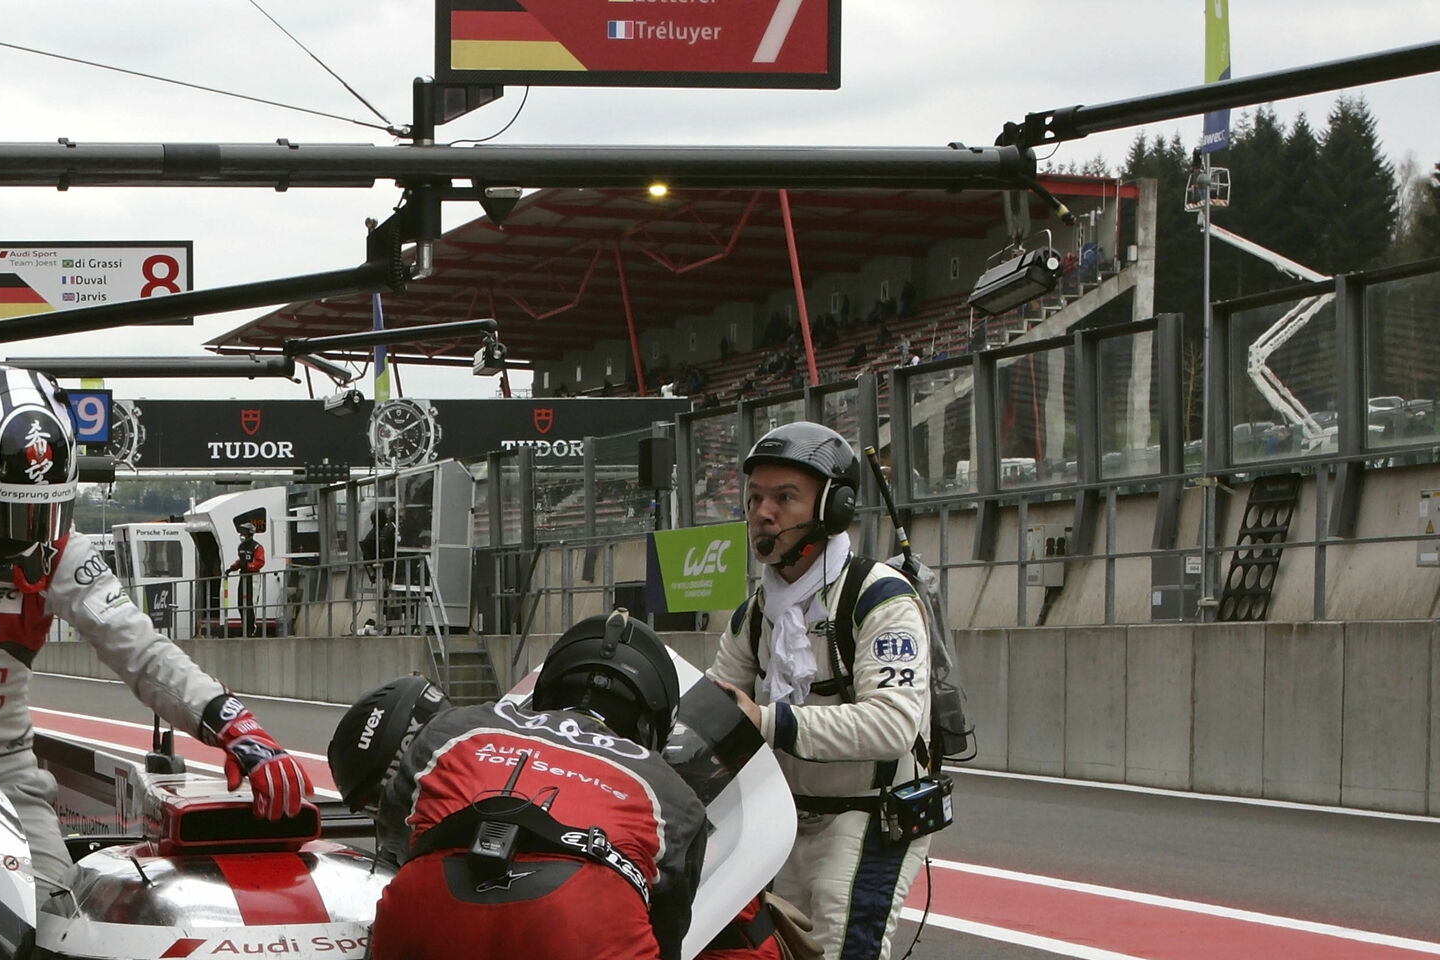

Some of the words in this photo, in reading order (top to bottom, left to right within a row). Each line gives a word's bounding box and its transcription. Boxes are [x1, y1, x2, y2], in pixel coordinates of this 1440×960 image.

[635, 20, 721, 45] Tréluyer
[10, 250, 31, 258] Audi
[32, 251, 57, 259] Sport
[10, 259, 33, 267] Team
[34, 259, 57, 268] Joest
[75, 258, 85, 268] di
[88, 259, 122, 269] Grassi
[75, 276, 107, 286] Duval
[140, 254, 181, 298] 8
[75, 292, 107, 303] Jarvis
[77, 396, 105, 435] 9
[207, 441, 294, 459] TUDOR
[683, 540, 731, 577] WEC
[877, 667, 914, 688] 28
[358, 707, 385, 751] uvex
[479, 743, 541, 759] Audi
[476, 752, 518, 766] Top
[532, 760, 628, 801] Service
[211, 938, 300, 954] Audi
[311, 937, 368, 953] Spo
